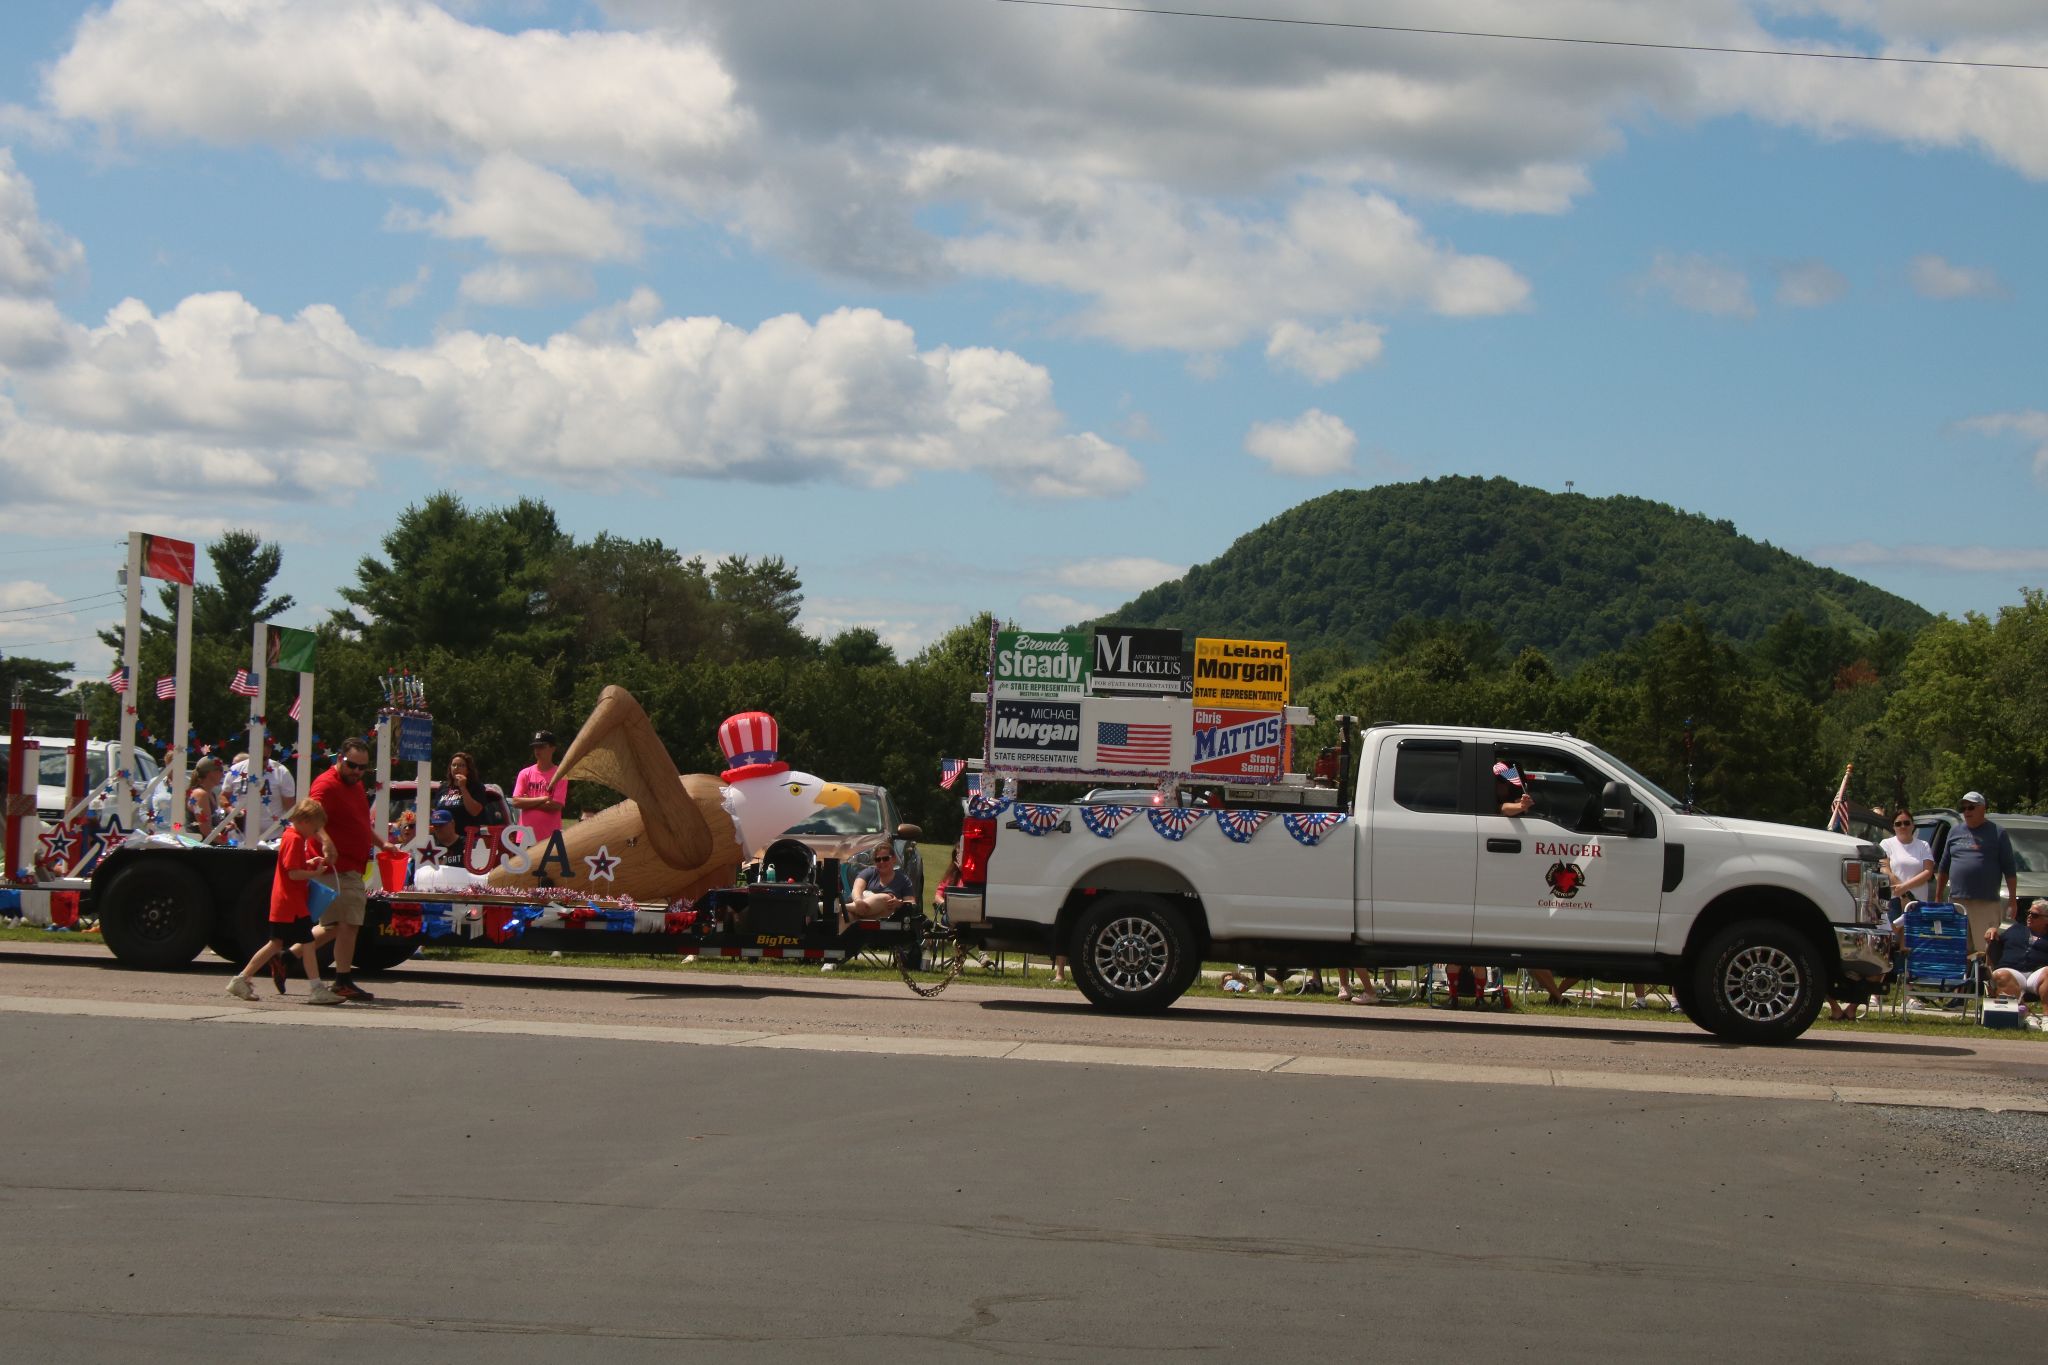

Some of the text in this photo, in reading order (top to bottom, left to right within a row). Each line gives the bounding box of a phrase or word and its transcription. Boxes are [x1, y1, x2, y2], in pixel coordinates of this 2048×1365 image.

[1014, 634, 1070, 652] Brenda
[1223, 644, 1284, 660] Leland
[998, 650, 1083, 683] Steady
[1197, 658, 1283, 683] Morgan
[1010, 682, 1029, 691] STATE
[1030, 683, 1081, 693] REPRESENTATIVE
[1127, 682, 1179, 690] REPRESENTATIVE
[1194, 687, 1282, 701] STATE REPRESENTATIVE
[1030, 708, 1078, 721] MICHAEL
[1195, 711, 1222, 724] Chris
[995, 717, 1079, 746] Morgan
[1195, 718, 1279, 761] MATTOS
[994, 751, 1078, 764] STATE REPRESENTATIVE
[1250, 754, 1276, 764] State
[1241, 762, 1276, 773] Senate
[463, 824, 576, 878] USA
[1535, 842, 1602, 858] RANGER
[756, 935, 800, 947] BigTex
